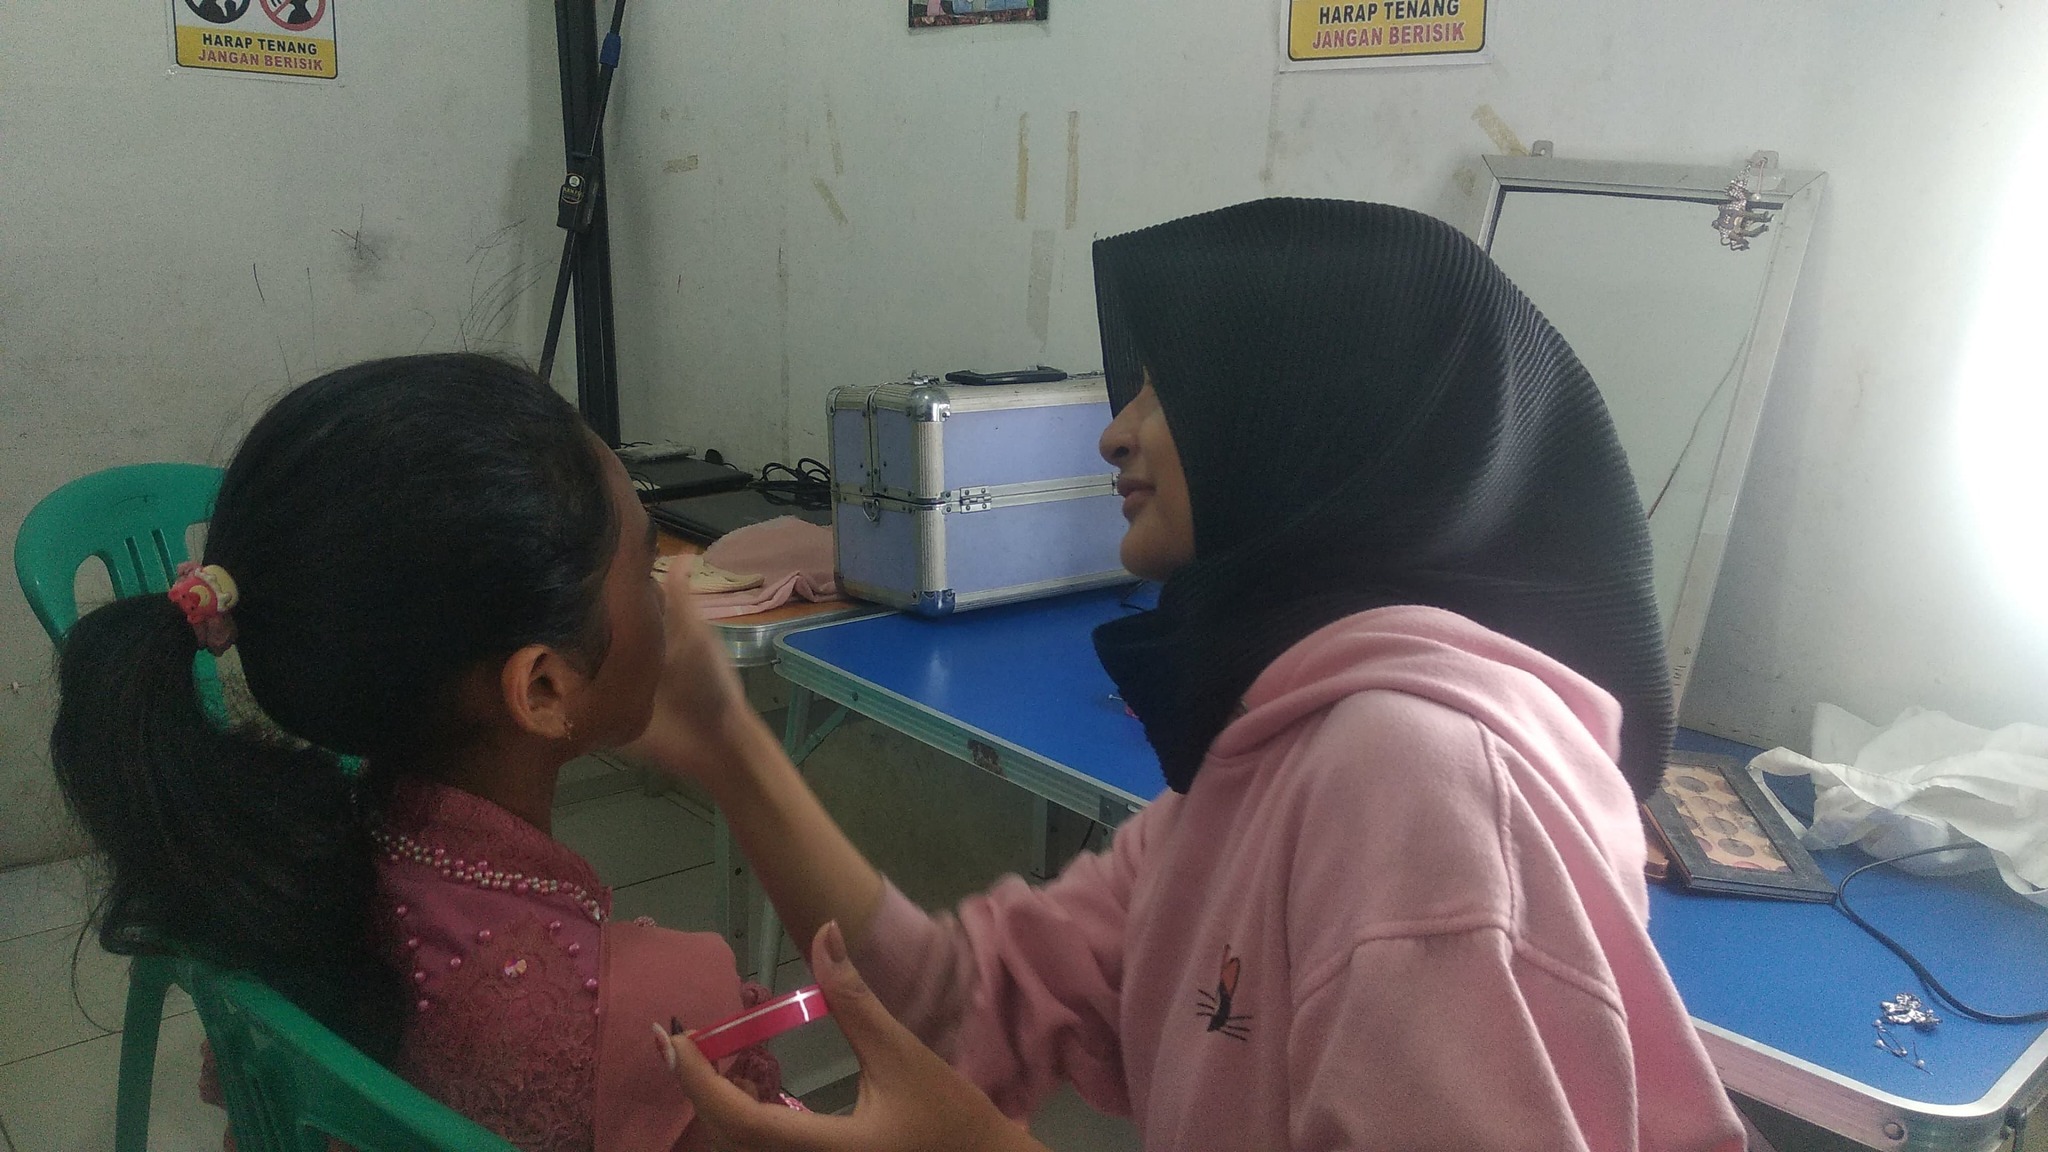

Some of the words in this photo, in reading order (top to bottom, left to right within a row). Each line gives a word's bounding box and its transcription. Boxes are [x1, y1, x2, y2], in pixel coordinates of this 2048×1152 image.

[1319, 3, 1378, 24] HARAP
[1384, 0, 1459, 20] TENANG
[203, 33, 252, 49] HARAP
[258, 38, 317, 55] TENANG
[1312, 27, 1383, 49] JANGAN
[1389, 22, 1465, 45] BERISIK
[199, 50, 259, 65] JANGAN
[264, 55, 323, 71] BERISIK
